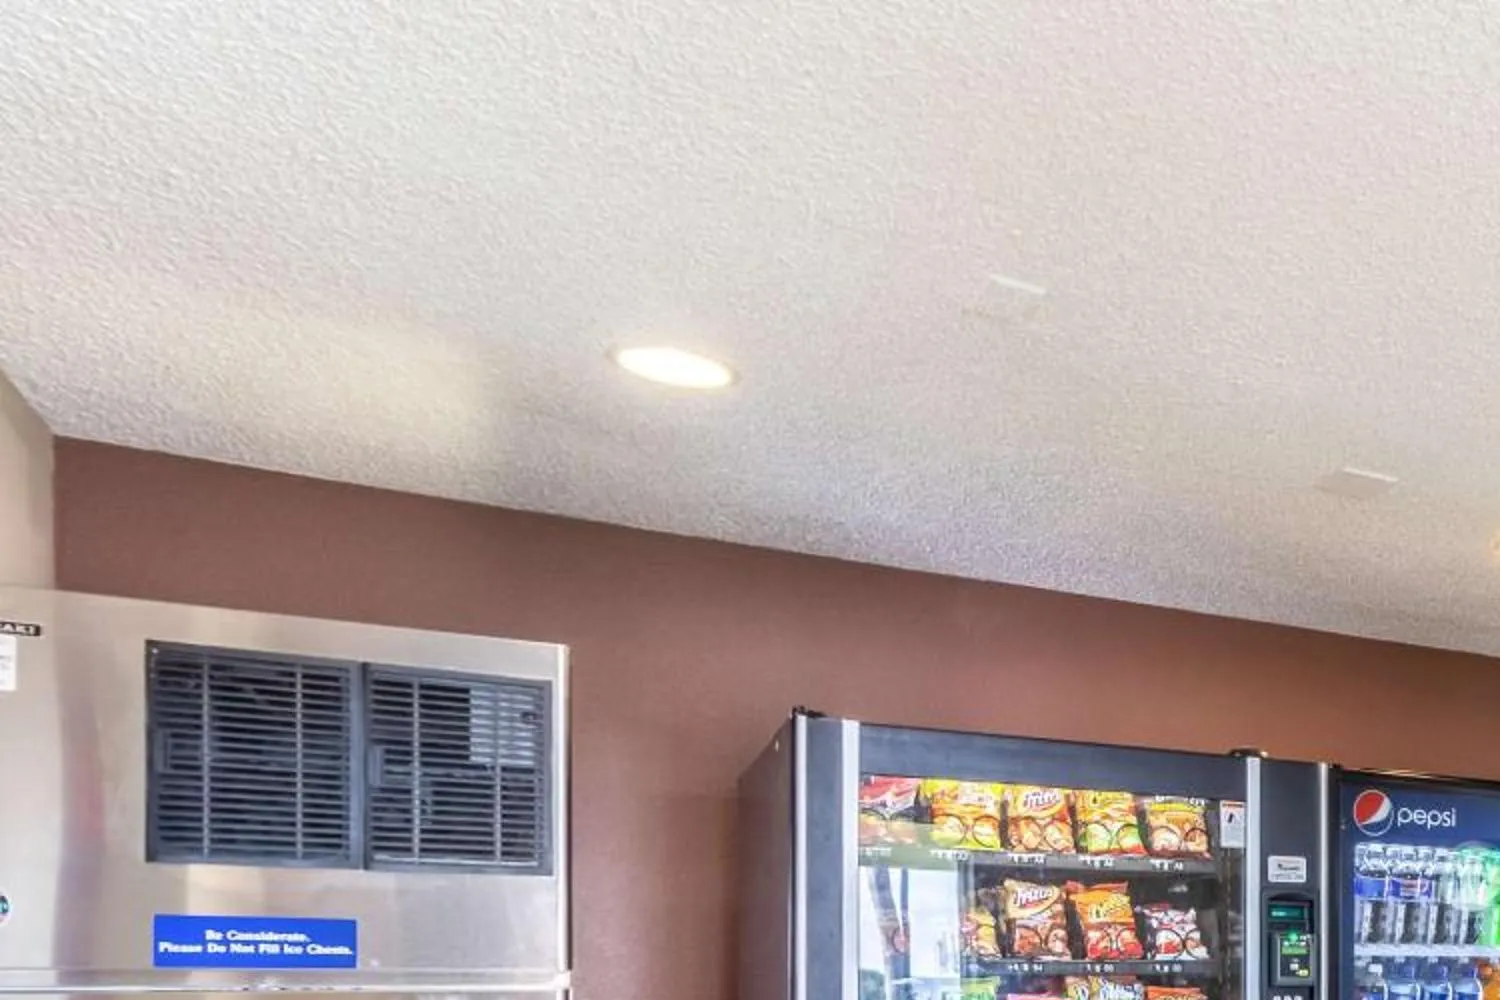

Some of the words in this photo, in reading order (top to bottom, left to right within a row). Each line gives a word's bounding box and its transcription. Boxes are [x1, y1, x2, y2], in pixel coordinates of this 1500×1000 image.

[1397, 807, 1456, 830] pepsi
[205, 929, 223, 941] Be
[158, 942, 202, 953] Please
[207, 943, 227, 953] Do
[230, 943, 255, 954] Not
